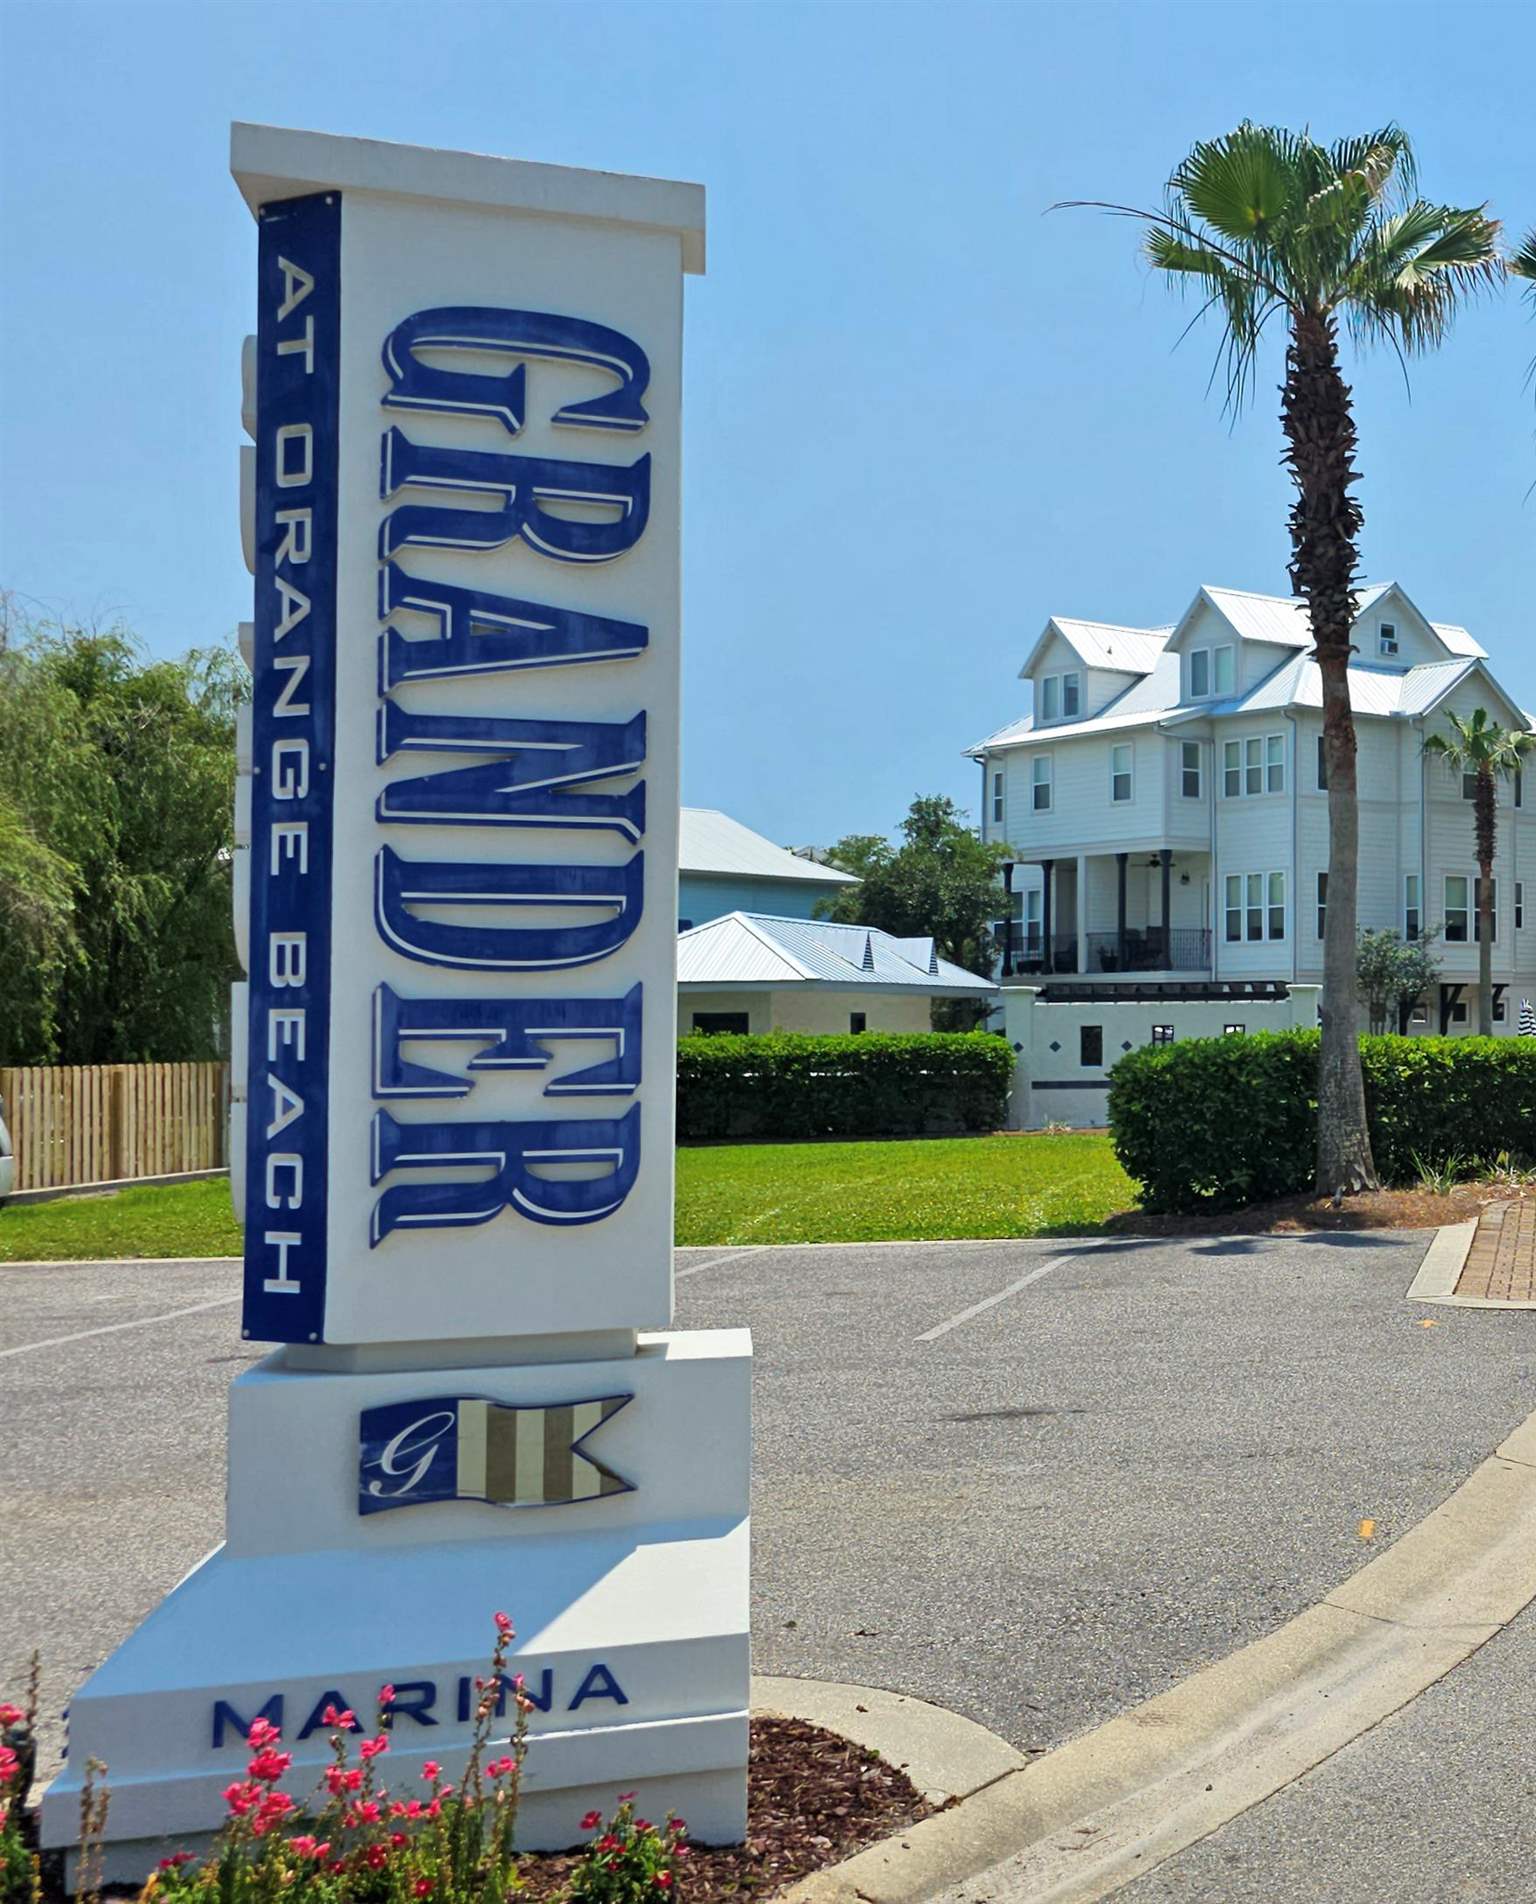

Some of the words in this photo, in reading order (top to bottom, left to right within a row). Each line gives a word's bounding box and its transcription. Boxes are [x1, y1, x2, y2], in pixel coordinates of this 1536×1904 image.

[276, 255, 315, 374] AT
[270, 422, 314, 877] ORANGE
[369, 305, 652, 1250] GRANDER
[263, 931, 308, 1295] BEACH
[211, 1663, 630, 1749] MARINA
